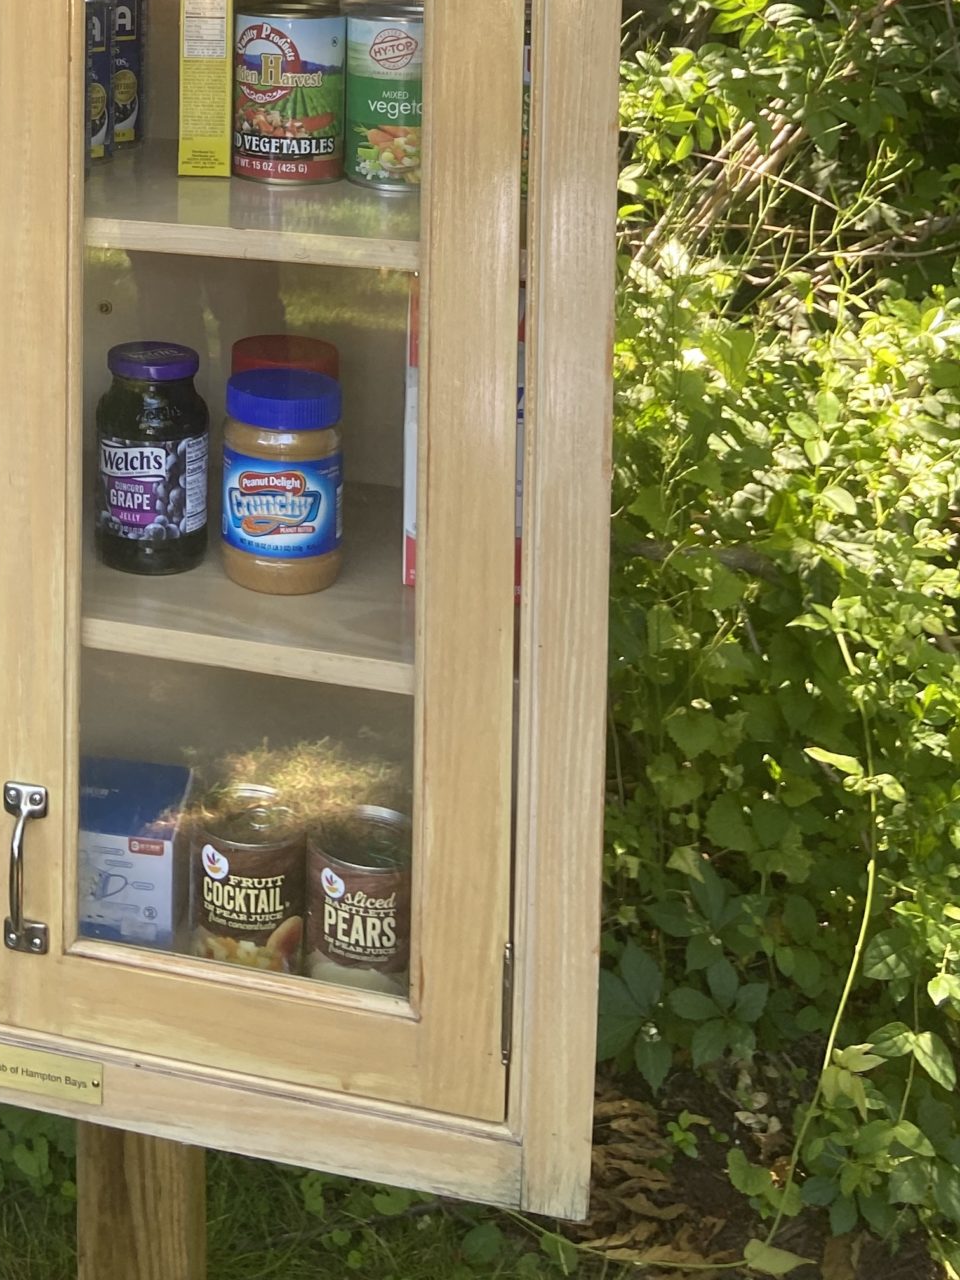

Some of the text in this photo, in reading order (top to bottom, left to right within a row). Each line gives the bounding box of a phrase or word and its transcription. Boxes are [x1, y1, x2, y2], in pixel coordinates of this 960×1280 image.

[261, 23, 296, 61] Products
[261, 53, 324, 87] Harvest
[382, 91, 409, 99] MIXED
[243, 134, 334, 155] VEGETABLES
[252, 160, 261, 170] 15
[278, 163, 296, 173] (425
[298, 164, 308, 174] G)
[103, 450, 163, 471] Welch's
[115, 481, 144, 493] CONCORD
[242, 476, 301, 490] Peanut Delight
[110, 489, 151, 511] GRAPE
[231, 489, 314, 519] Crunchy
[119, 512, 140, 522] JELLY
[228, 874, 285, 888] FRUIT
[204, 876, 284, 913] COCKTAIL
[344, 891, 396, 908] sliced
[204, 901, 283, 922] IN PEAR JUICE
[324, 895, 396, 917] BARTLETT
[228, 921, 276, 930] concentrate
[324, 904, 396, 947] PEARS
[335, 940, 363, 953] PEAR
[364, 947, 396, 955] JUICE
[10, 1066, 19, 1074] of
[21, 1067, 62, 1083] Hampton
[64, 1076, 88, 1089] Bays
